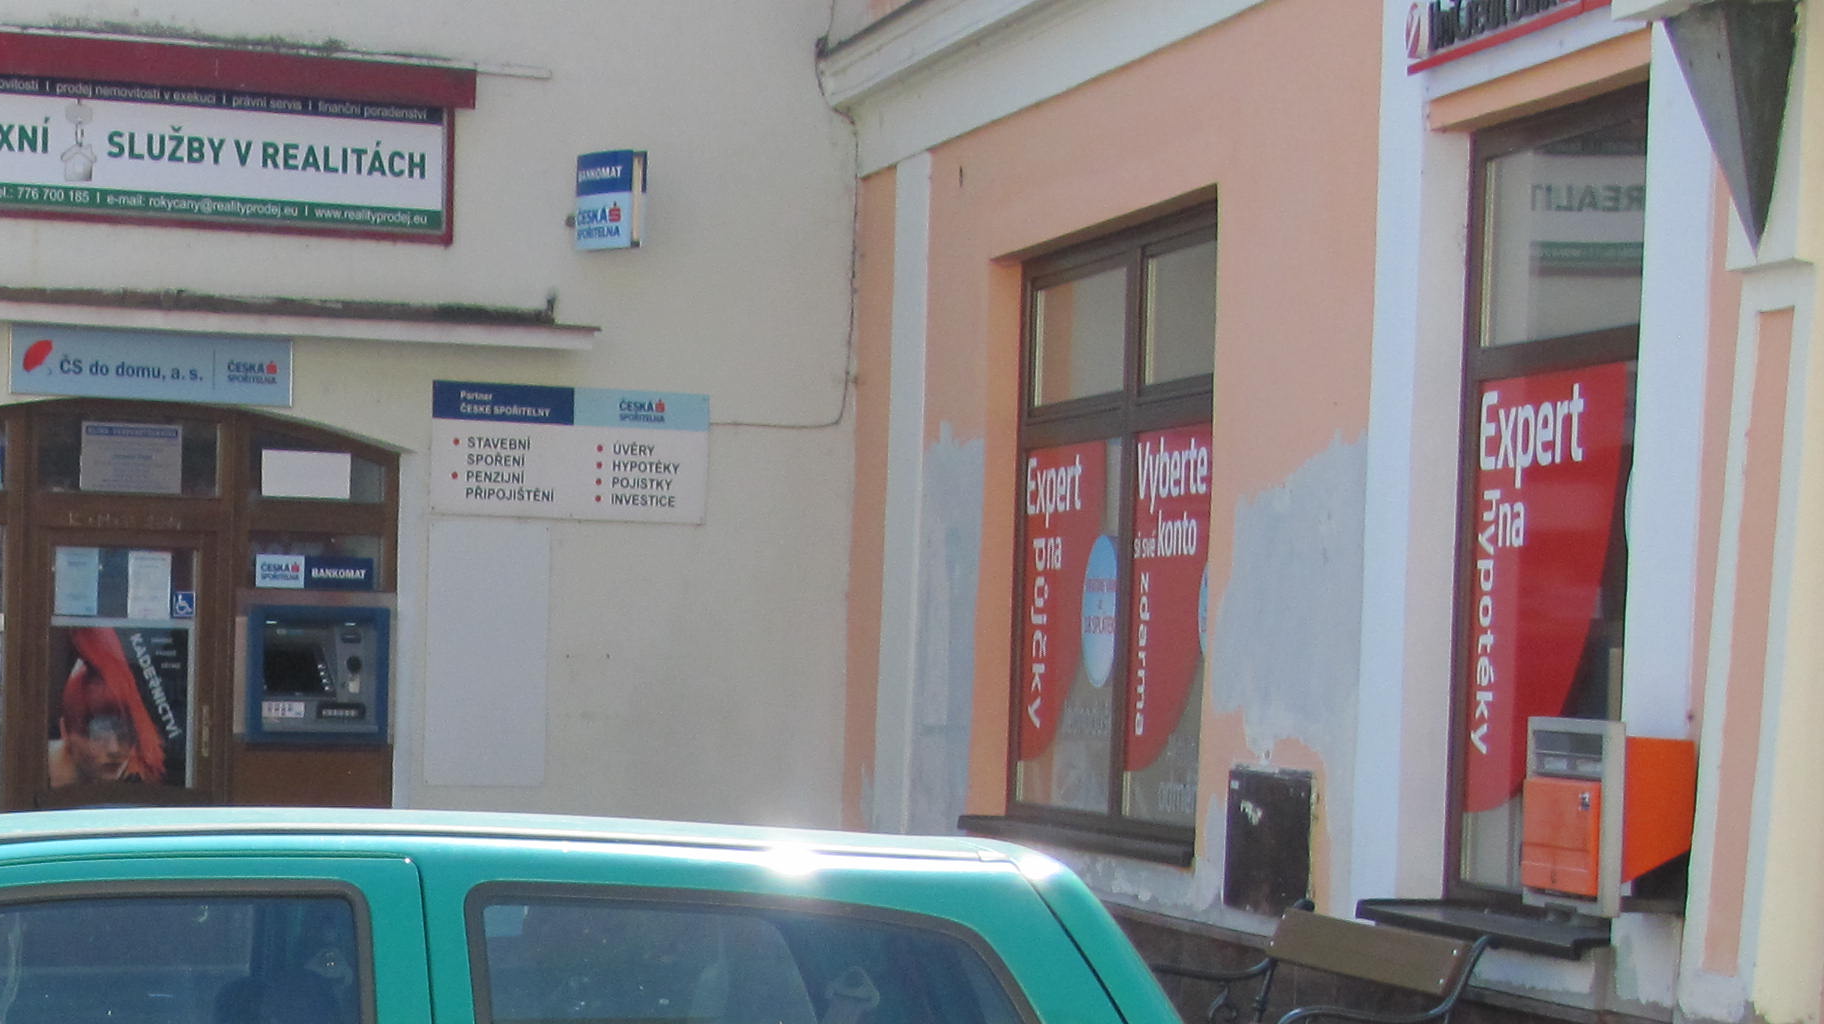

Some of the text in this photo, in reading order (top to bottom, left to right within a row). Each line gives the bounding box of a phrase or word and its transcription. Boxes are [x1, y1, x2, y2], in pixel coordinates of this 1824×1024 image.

[56, 83, 92, 97] prodej
[163, 91, 170, 100] v
[174, 91, 215, 105] exekuci
[232, 95, 301, 111] právní servis
[318, 103, 427, 121] finanční poradenství
[107, 125, 225, 165] SLUŽBY
[234, 139, 252, 167] V
[261, 140, 426, 180] REALITÁCH
[17, 187, 39, 200] 776
[43, 189, 64, 202] 700
[69, 190, 89, 204] 185
[107, 193, 298, 219] e-mail: rokycany@realityprodej.eu
[314, 206, 427, 226] www.realityprodej.eu
[59, 355, 203, 382] ČS do domu, a. s.
[460, 391, 493, 401] Partner
[460, 403, 551, 418] ČESKÉ SPOŘITELNY
[467, 436, 531, 451] STAVEBNÍ
[1480, 383, 1584, 488] Expert
[613, 441, 655, 456] ÚVĚRY
[466, 452, 525, 467] SPOŘENÍ
[612, 460, 680, 475] HYPOTÉKY
[466, 469, 525, 484] PENZIJNÍ
[611, 477, 672, 491] POJISTKY
[1136, 437, 1208, 513] Vyberte
[465, 485, 554, 502] PŘIPOJIŠTĚNÍ
[611, 494, 675, 507] INVESTICE
[1026, 454, 1083, 528] Expert
[1497, 501, 1525, 547] na
[1156, 510, 1197, 558] konto
[1046, 536, 1062, 570] na
[311, 567, 367, 580] BANKOMAT
[1470, 489, 1497, 754] hypotéky
[1027, 538, 1048, 728] půjčky
[1135, 571, 1150, 736] zdarma
